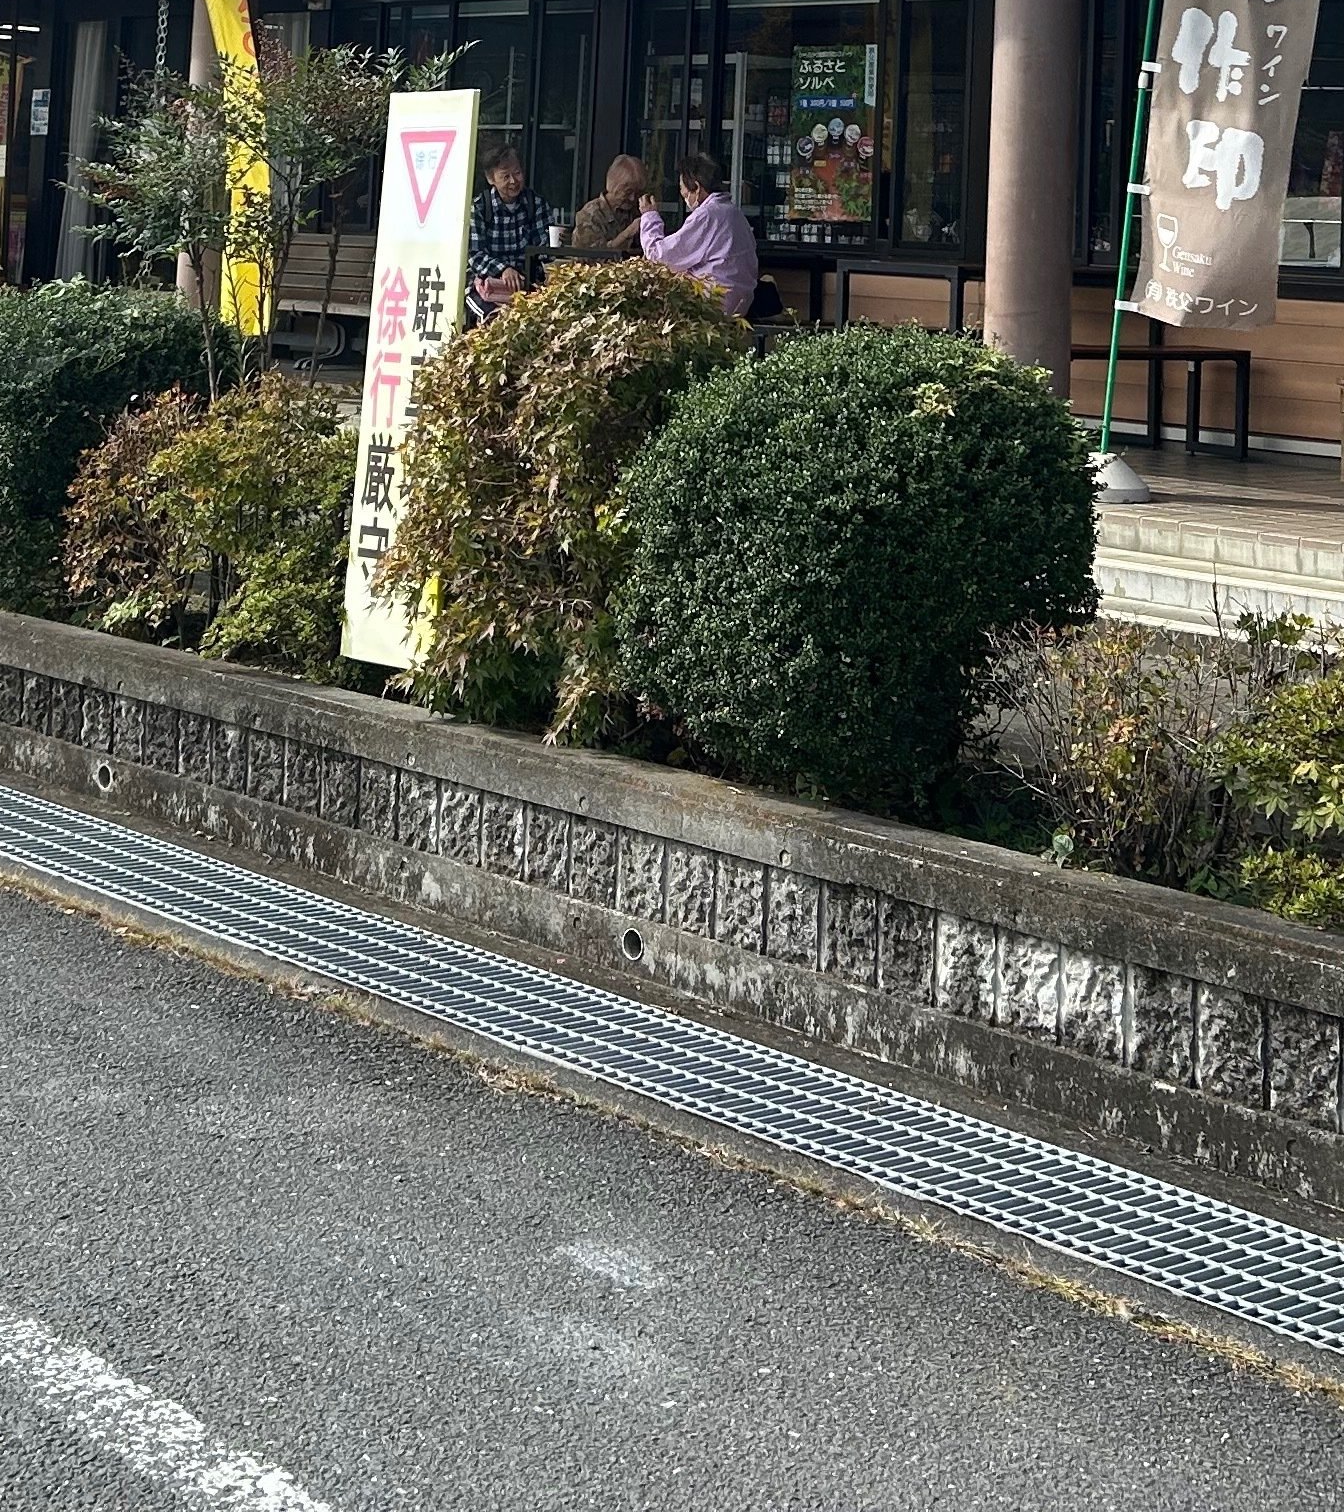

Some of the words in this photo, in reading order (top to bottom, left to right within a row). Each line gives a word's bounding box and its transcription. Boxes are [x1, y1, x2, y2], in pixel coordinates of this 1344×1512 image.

[799, 59, 846, 74] ふるさと
[1258, 24, 1288, 106] ワイン
[798, 76, 835, 90] ソルベ
[1172, 245, 1213, 266] Gensaku
[1172, 260, 1195, 278] Wine
[357, 266, 410, 597] 徐行厳守
